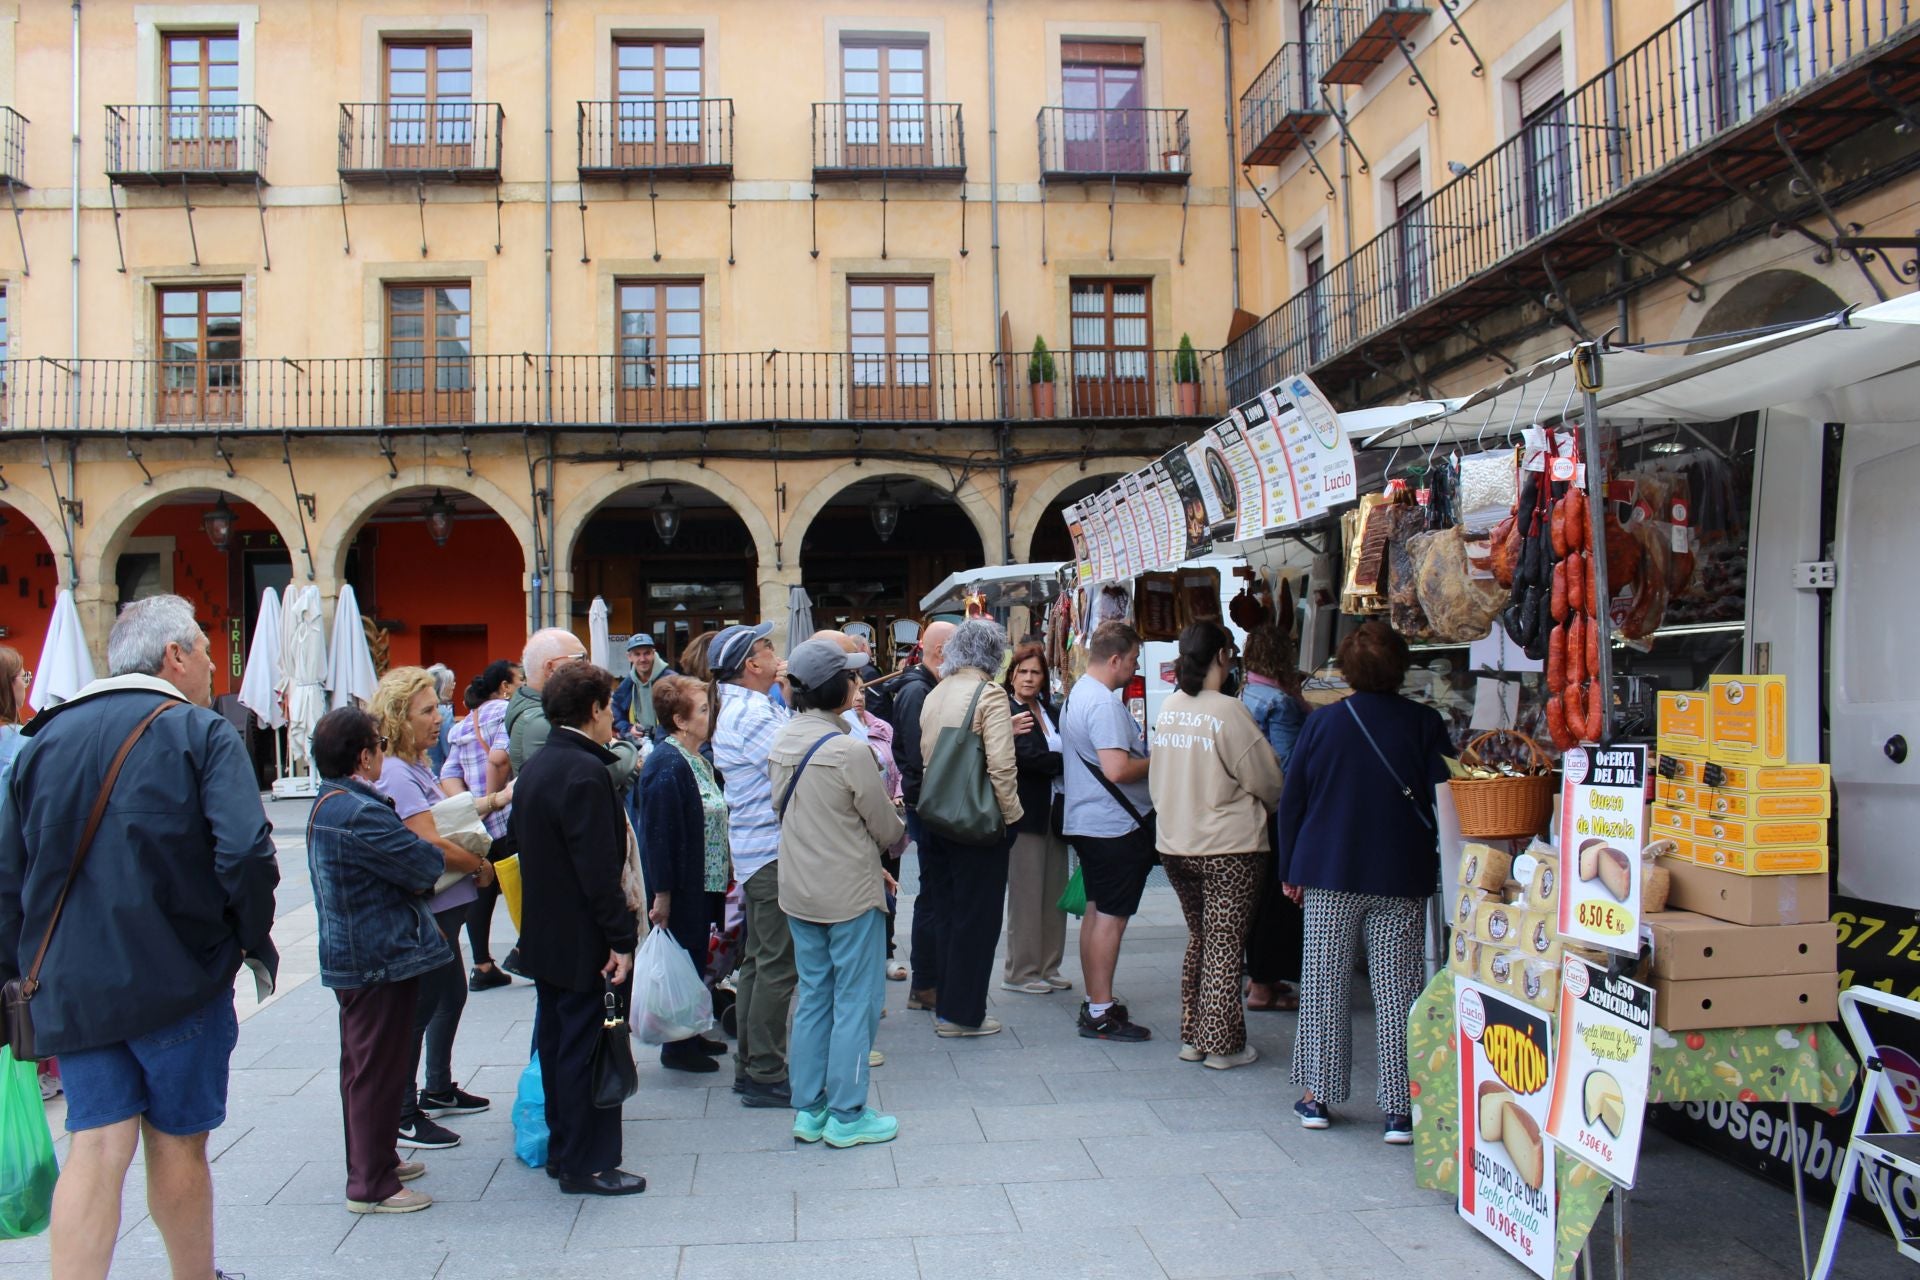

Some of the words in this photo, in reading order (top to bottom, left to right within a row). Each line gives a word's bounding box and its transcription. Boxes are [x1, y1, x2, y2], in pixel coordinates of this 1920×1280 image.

[1245, 403, 1264, 422] LOMO
[1323, 472, 1351, 492] Lucio
[231, 618, 242, 678] TRIBU
[1594, 768, 1613, 784] DEL
[1615, 766, 1635, 784] DÍA
[1590, 789, 1624, 812] Queso
[1576, 815, 1589, 834] de
[1592, 816, 1635, 839] Mezcla
[1580, 903, 1602, 927] 8,50
[1606, 908, 1614, 929] €
[1566, 969, 1587, 985] Lucio
[1461, 1002, 1482, 1020] Lucio
[1588, 986, 1648, 1026] SEMICURADO
[1576, 1021, 1598, 1042] Mezcla
[1599, 1025, 1615, 1041] Vaca
[1623, 1028, 1643, 1054] Oveja
[1484, 1023, 1547, 1094] OFERTÓN
[1591, 1042, 1605, 1065] Bajo
[1607, 1047, 1615, 1061] en
[1616, 1047, 1629, 1063] Sal
[1469, 1147, 1491, 1179] QUESO
[1493, 1161, 1513, 1193] PURO
[1514, 1176, 1523, 1201] de
[1525, 1182, 1548, 1218] OVEJA
[1478, 1177, 1505, 1209] Leche
[1506, 1195, 1539, 1235] Cruda
[1486, 1206, 1517, 1242] 10,90€
